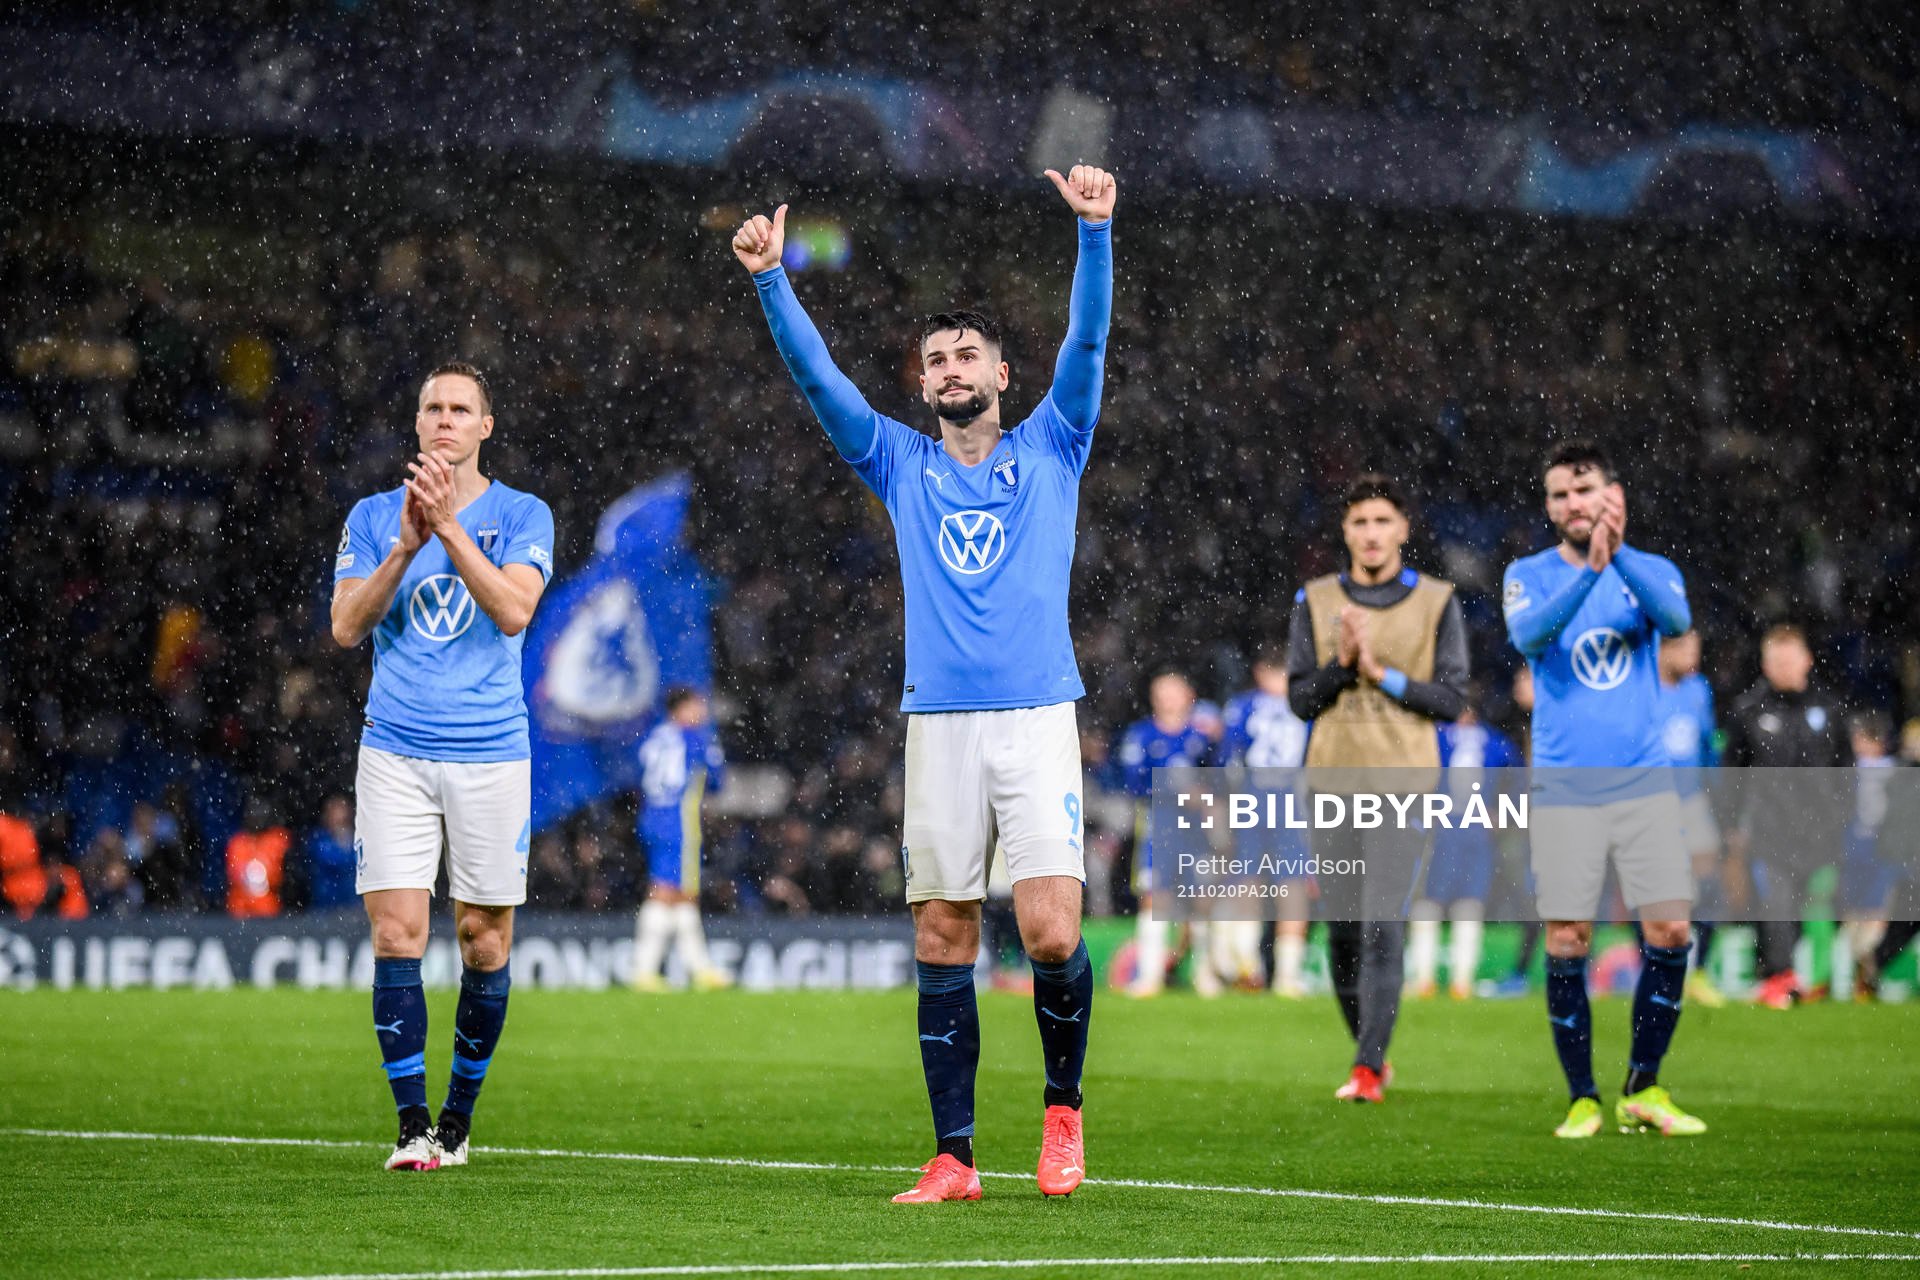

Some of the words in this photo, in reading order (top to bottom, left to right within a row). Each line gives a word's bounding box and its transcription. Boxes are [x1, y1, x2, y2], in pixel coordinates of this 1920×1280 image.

[939, 510, 1005, 573] VW
[410, 575, 475, 640] VW
[1572, 628, 1631, 689] VW
[1063, 792, 1080, 836] 9
[53, 936, 234, 989] UEFA
[252, 936, 643, 989] CHAONS
